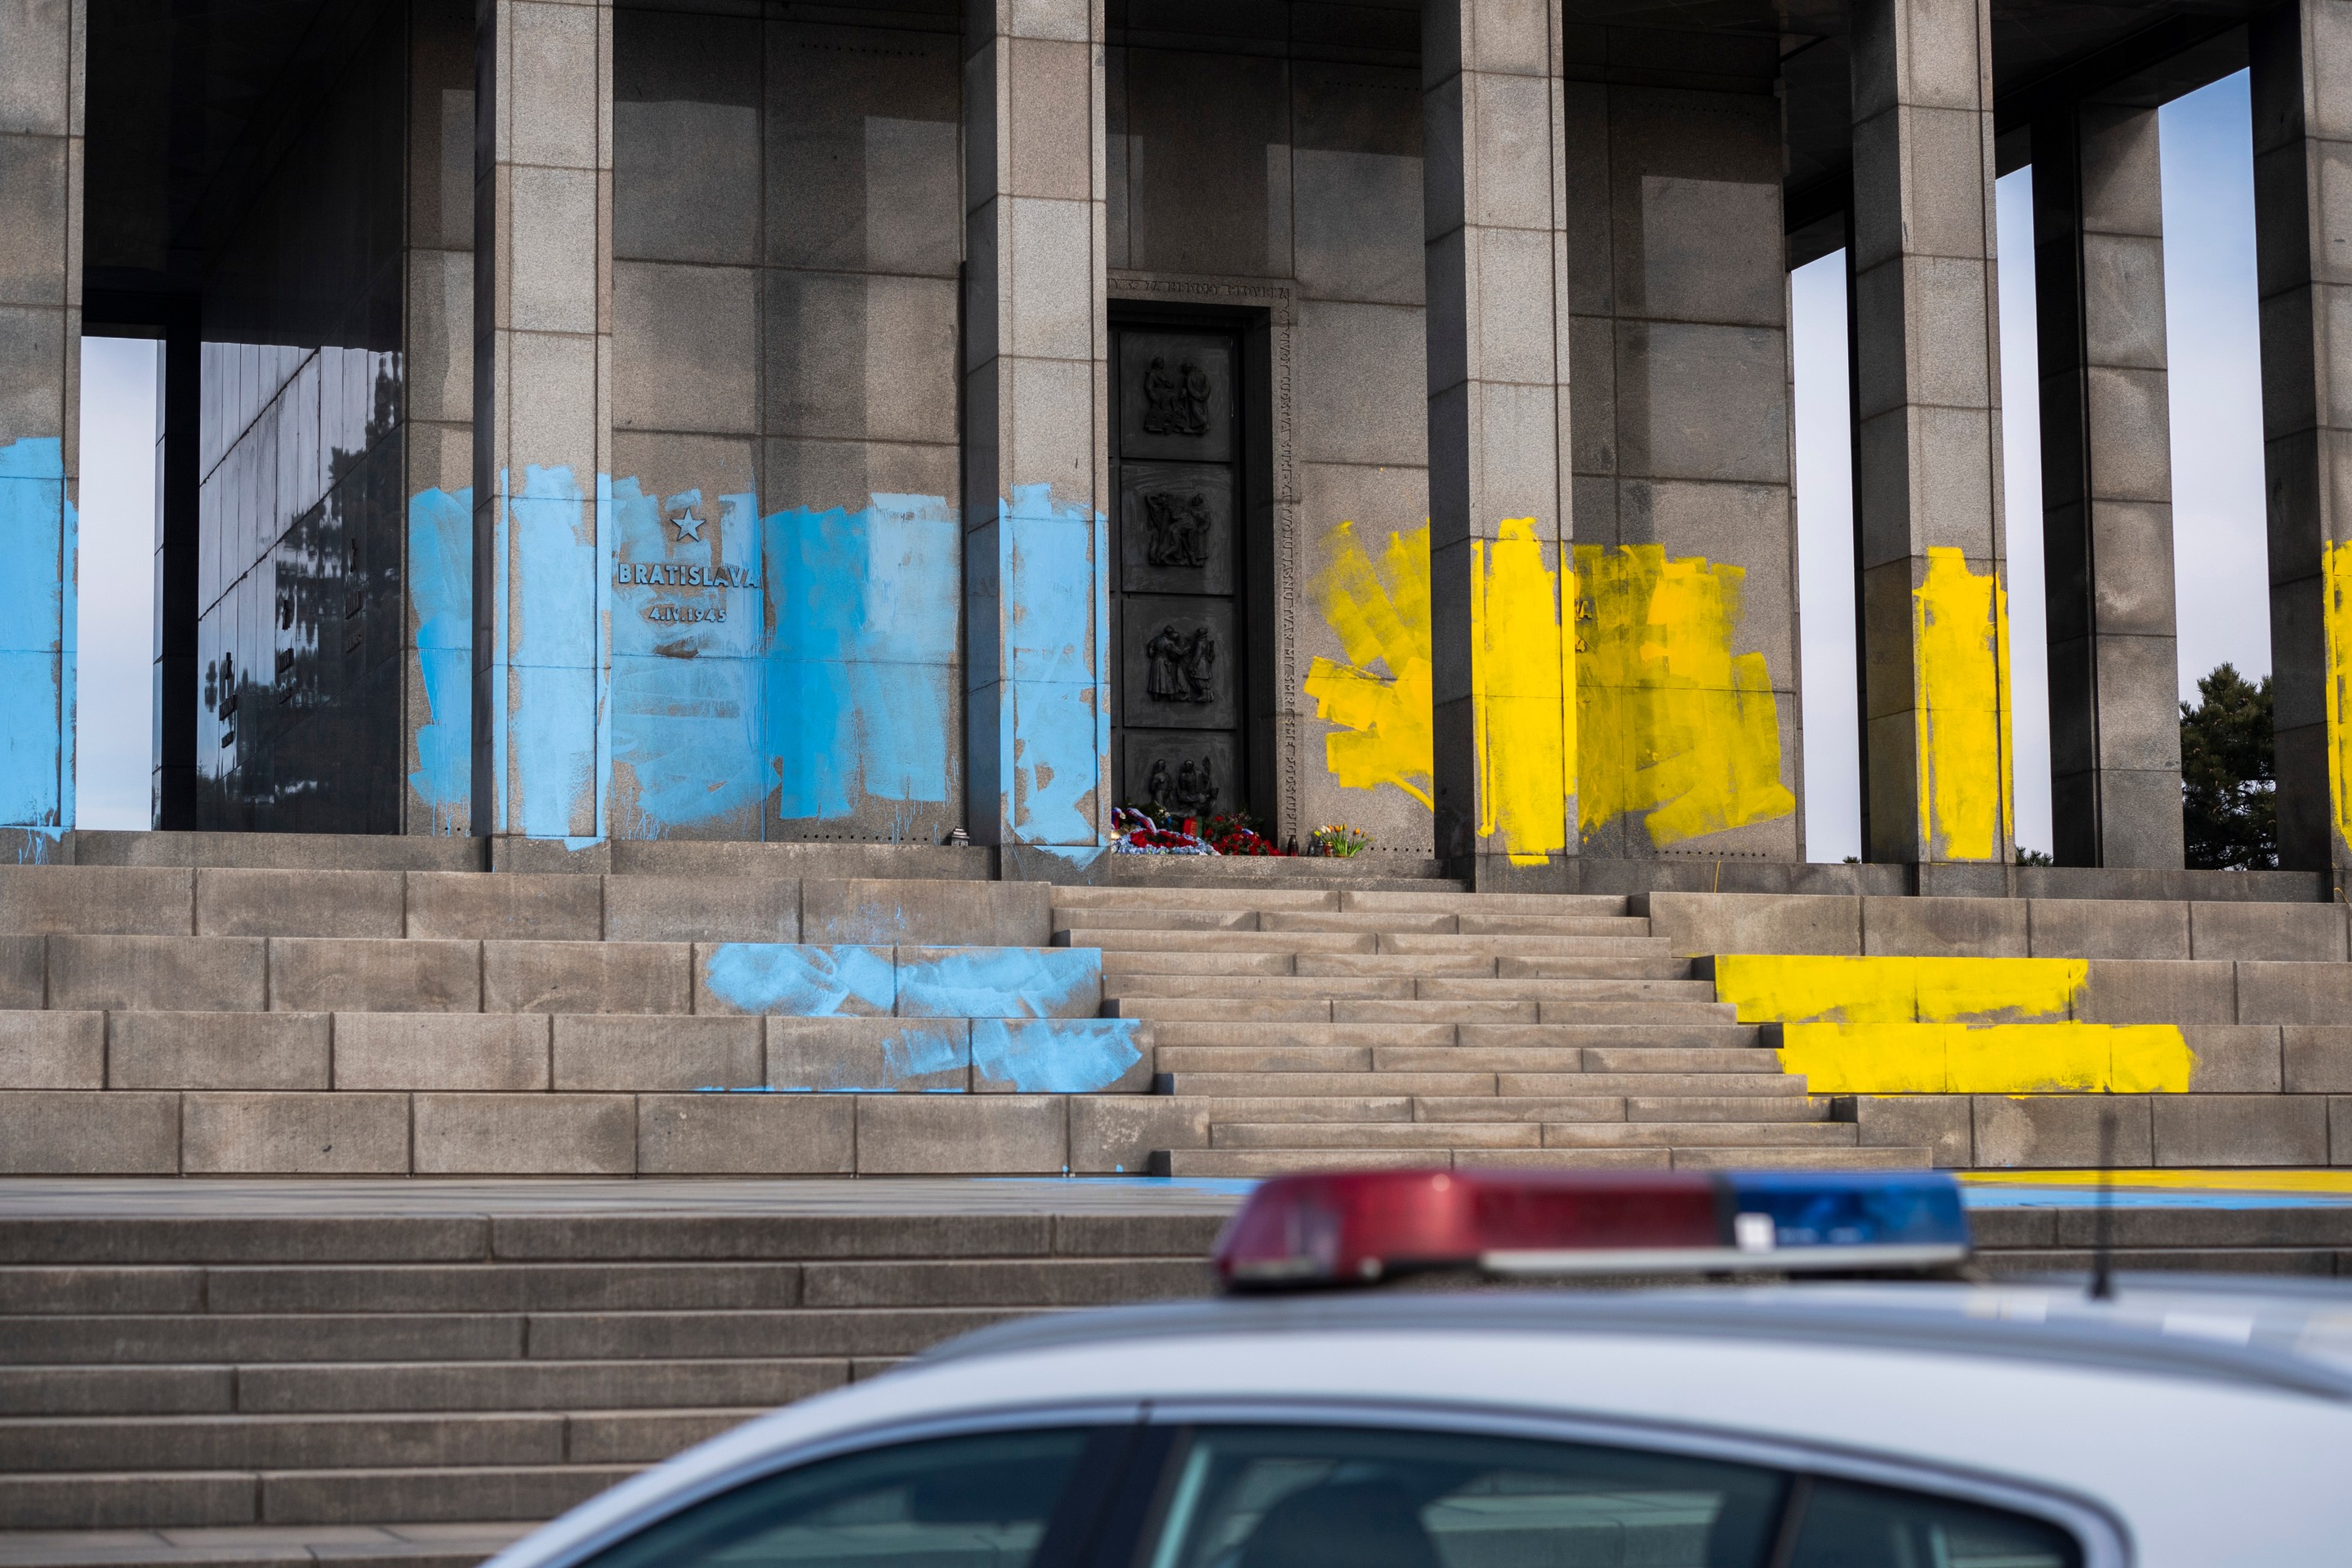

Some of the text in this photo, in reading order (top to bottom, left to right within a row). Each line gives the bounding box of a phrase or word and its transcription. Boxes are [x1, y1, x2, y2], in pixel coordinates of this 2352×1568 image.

[1282, 506, 1293, 547] TVOJU
[618, 563, 760, 589] BRATISLAVA
[1283, 555, 1294, 598] JASNU
[649, 607, 728, 623] 4.IV.1945
[1284, 606, 1294, 639] TVAR
[1285, 648, 1294, 666] MY
[1285, 674, 1295, 710] SMRT
[1285, 717, 1296, 746] SME
[1286, 756, 1298, 835] PODSTUPILI
